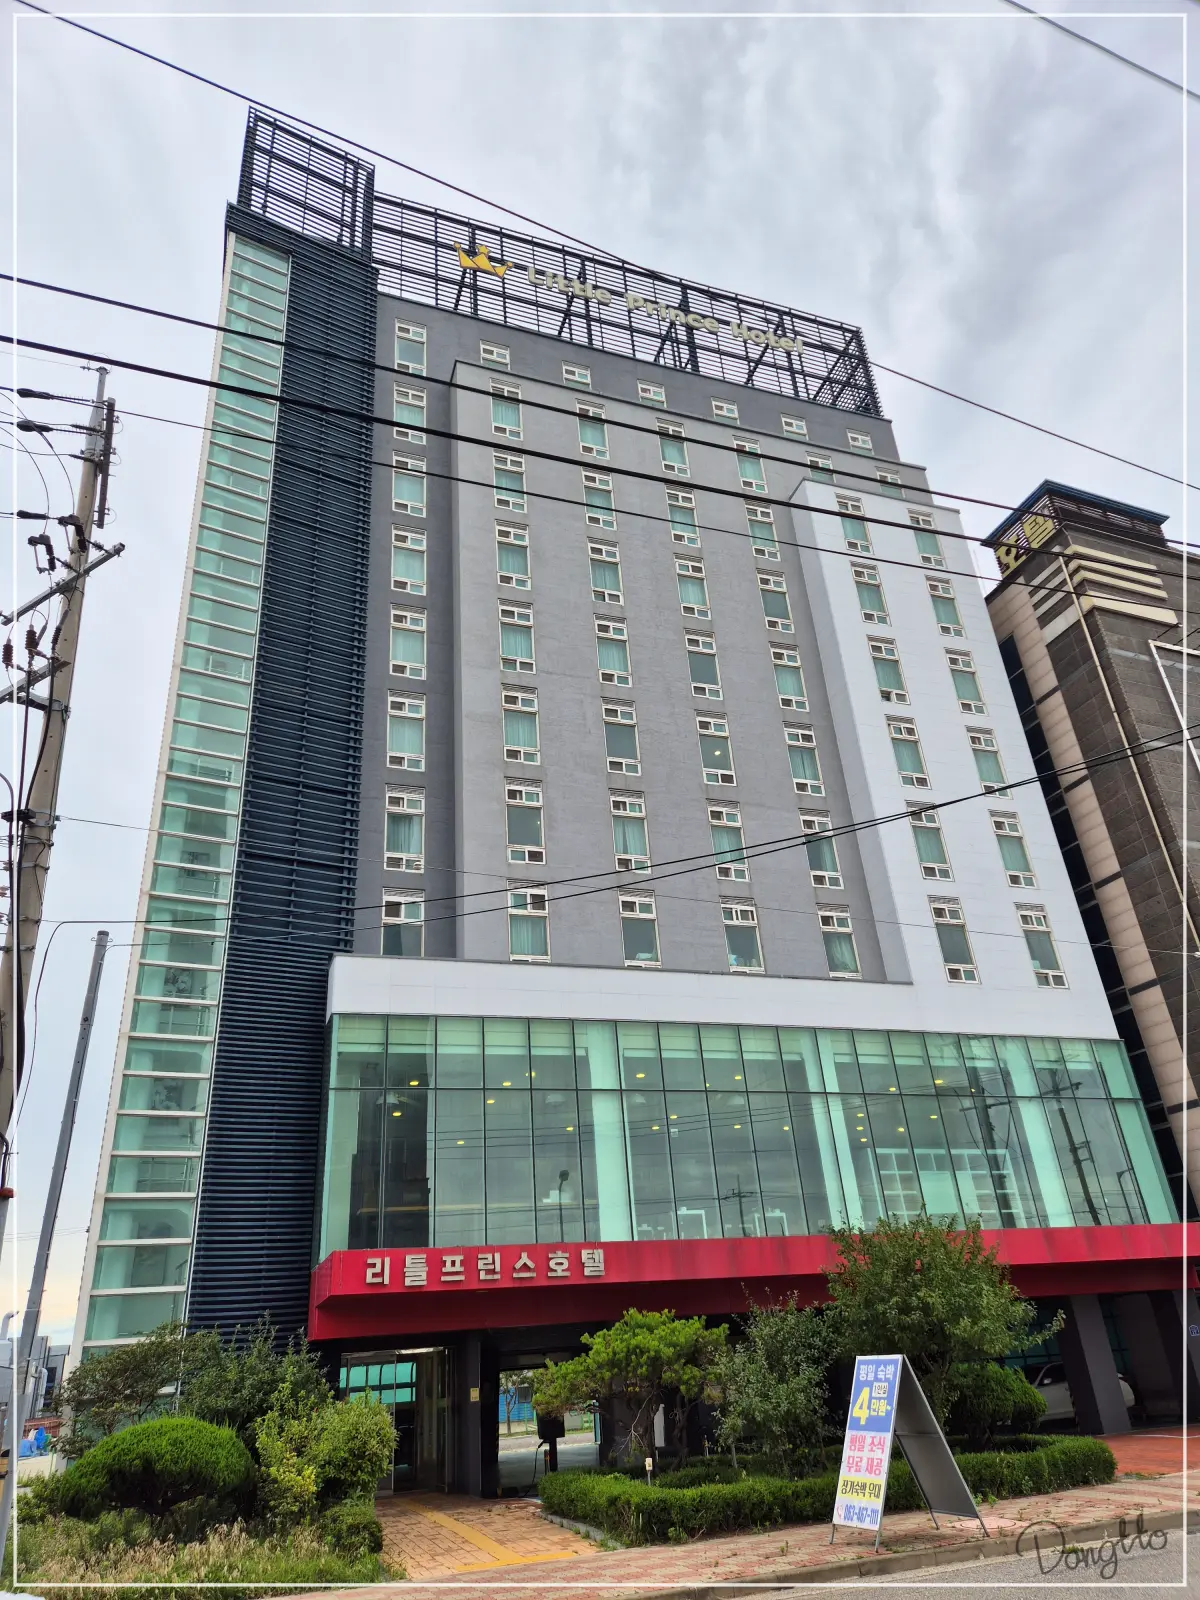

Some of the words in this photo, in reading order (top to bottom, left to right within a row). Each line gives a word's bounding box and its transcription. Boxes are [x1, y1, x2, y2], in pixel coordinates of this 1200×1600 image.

[527, 267, 612, 305] Little
[624, 292, 720, 333] Prince
[730, 321, 804, 354] Hotel
[859, 1364, 875, 1381] 평일
[877, 1364, 895, 1381] 숙박
[874, 1384, 888, 1395] 1인실
[849, 1434, 866, 1452] 평일
[868, 1435, 887, 1454] 조식
[846, 1455, 863, 1473] 무료
[865, 1457, 883, 1476] 제공
[841, 1480, 867, 1497] 장기숙박
[868, 1482, 881, 1499] 우대
